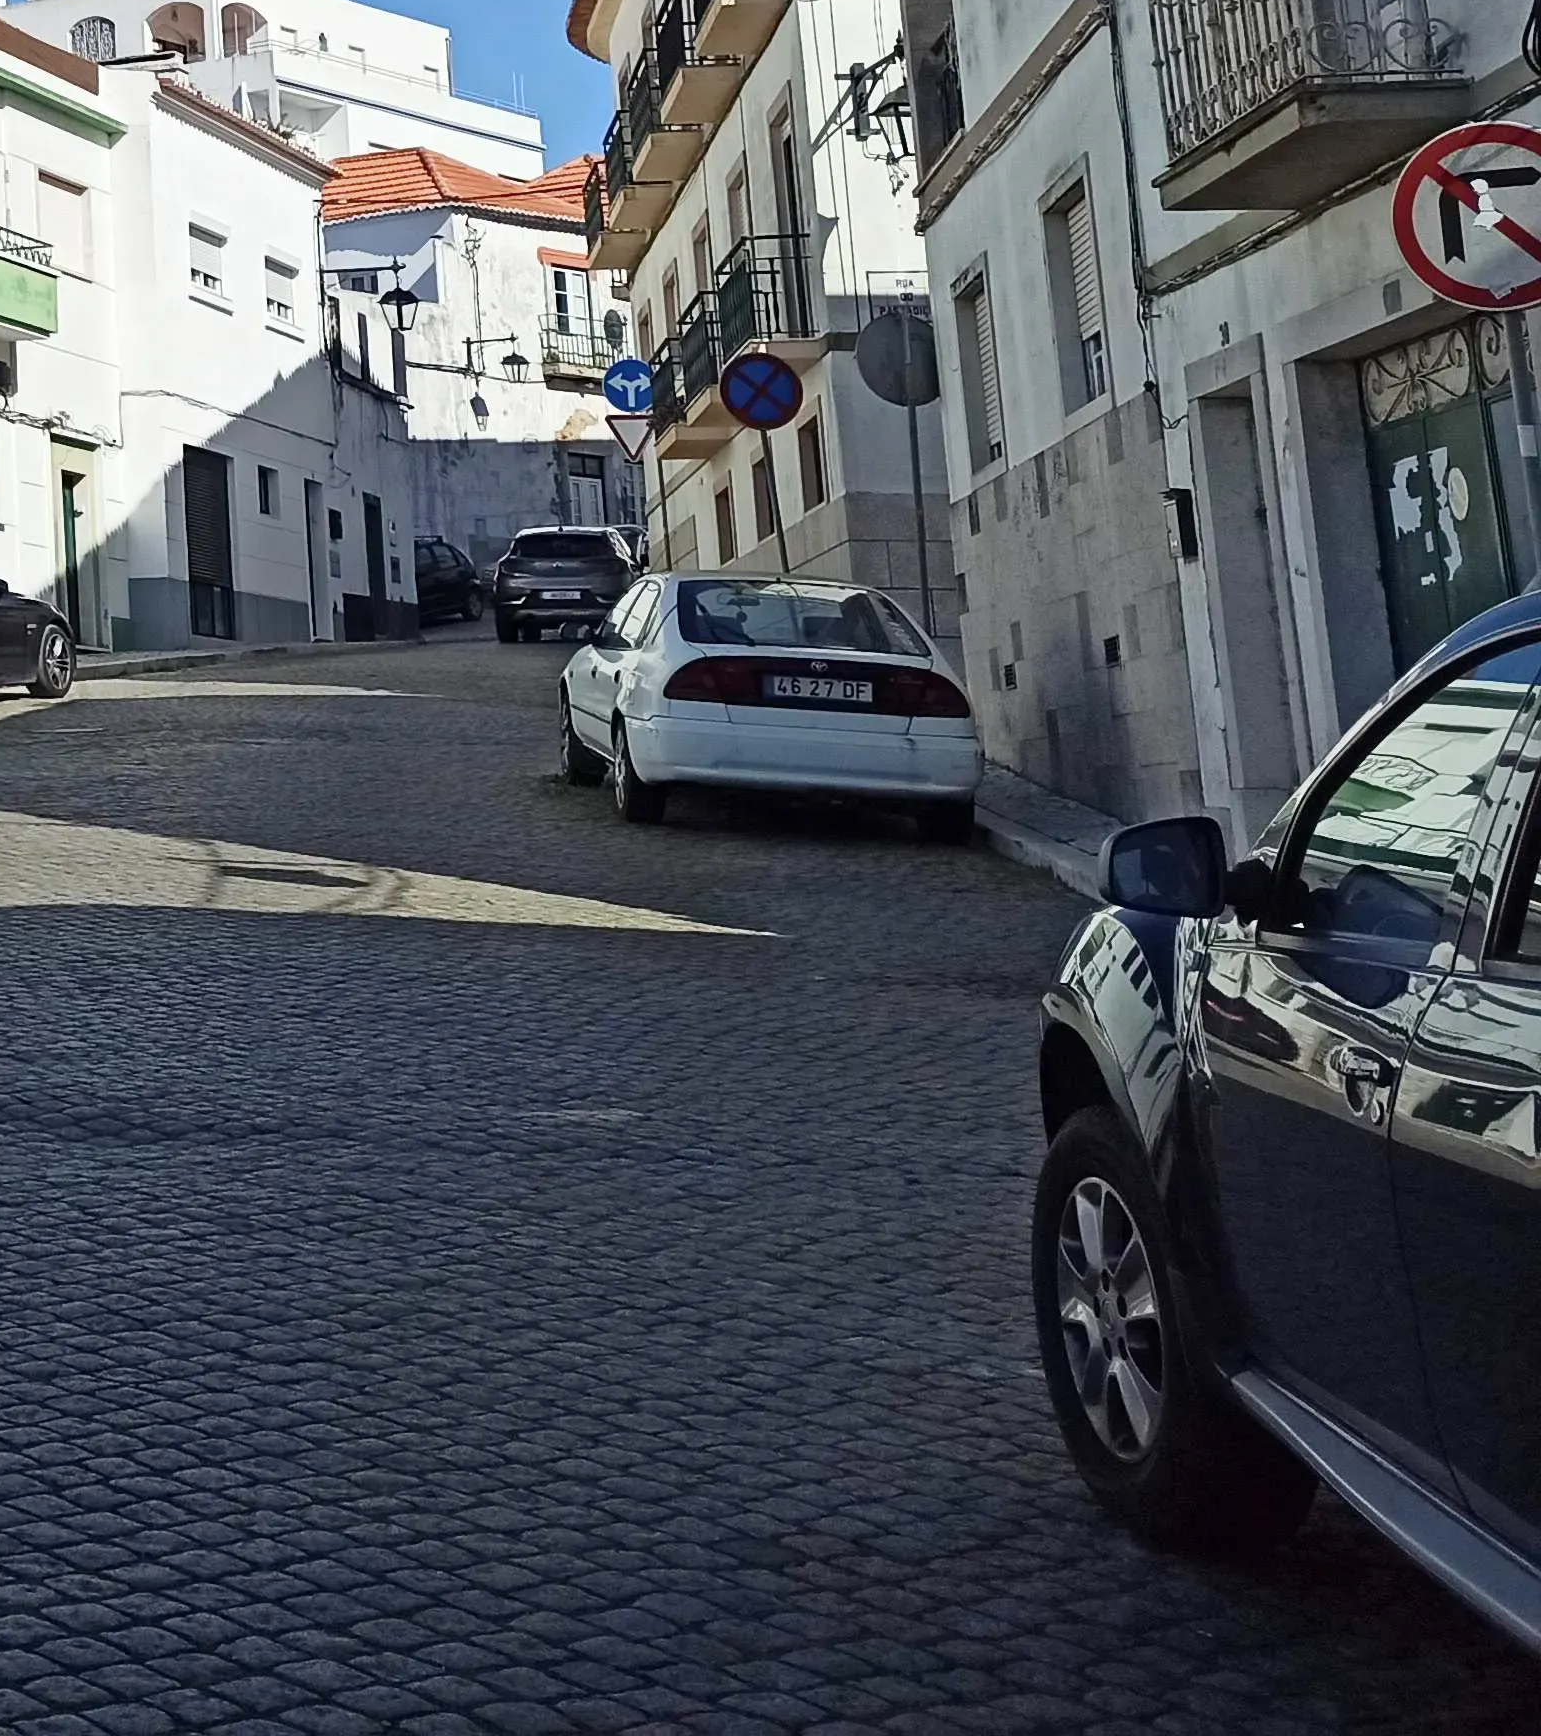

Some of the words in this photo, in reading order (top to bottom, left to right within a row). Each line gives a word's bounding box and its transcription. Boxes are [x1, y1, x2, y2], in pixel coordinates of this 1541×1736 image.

[895, 279, 914, 289] RUA
[777, 678, 802, 694] 46
[809, 680, 835, 697] 27
[842, 682, 869, 699] DF
